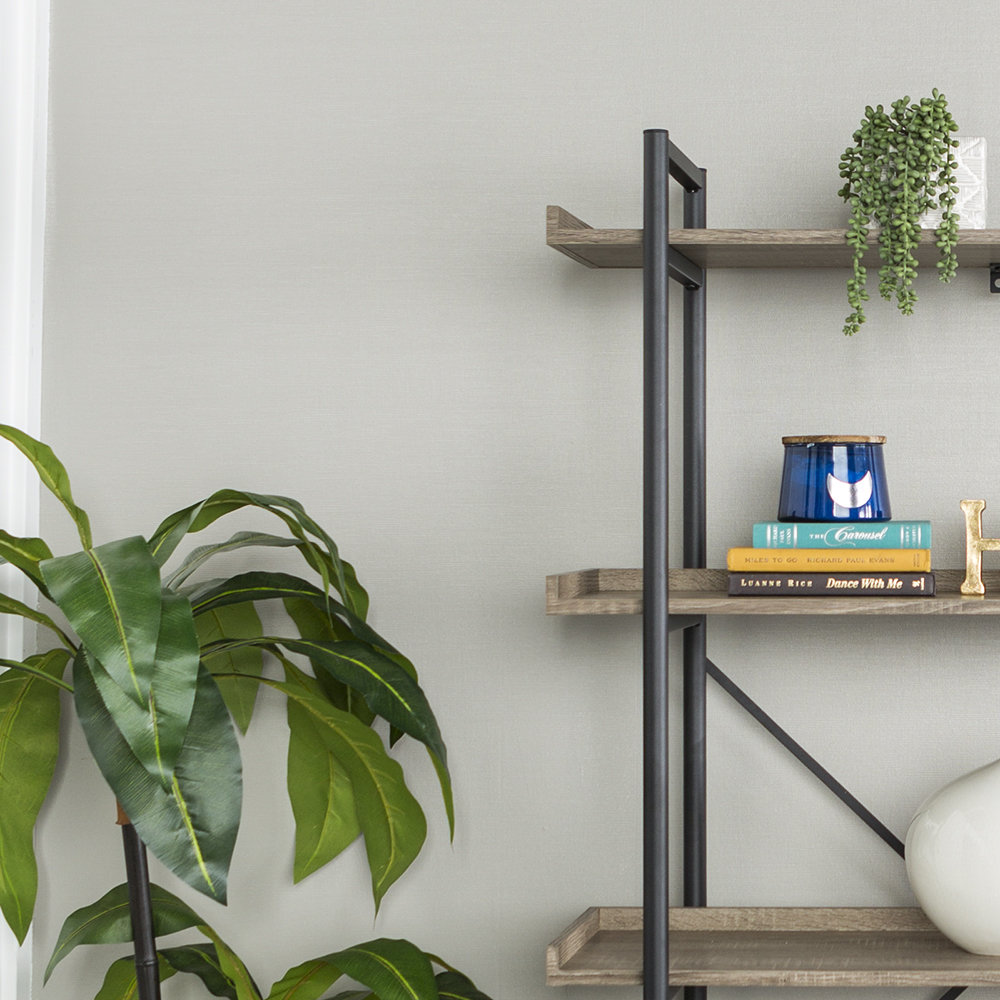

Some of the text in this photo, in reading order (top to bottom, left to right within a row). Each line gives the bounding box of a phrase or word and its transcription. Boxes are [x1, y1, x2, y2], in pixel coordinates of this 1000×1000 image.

[824, 526, 888, 546] Carousel
[741, 579, 813, 587] LUANNE RICE
[826, 577, 904, 589] Dance With Me
